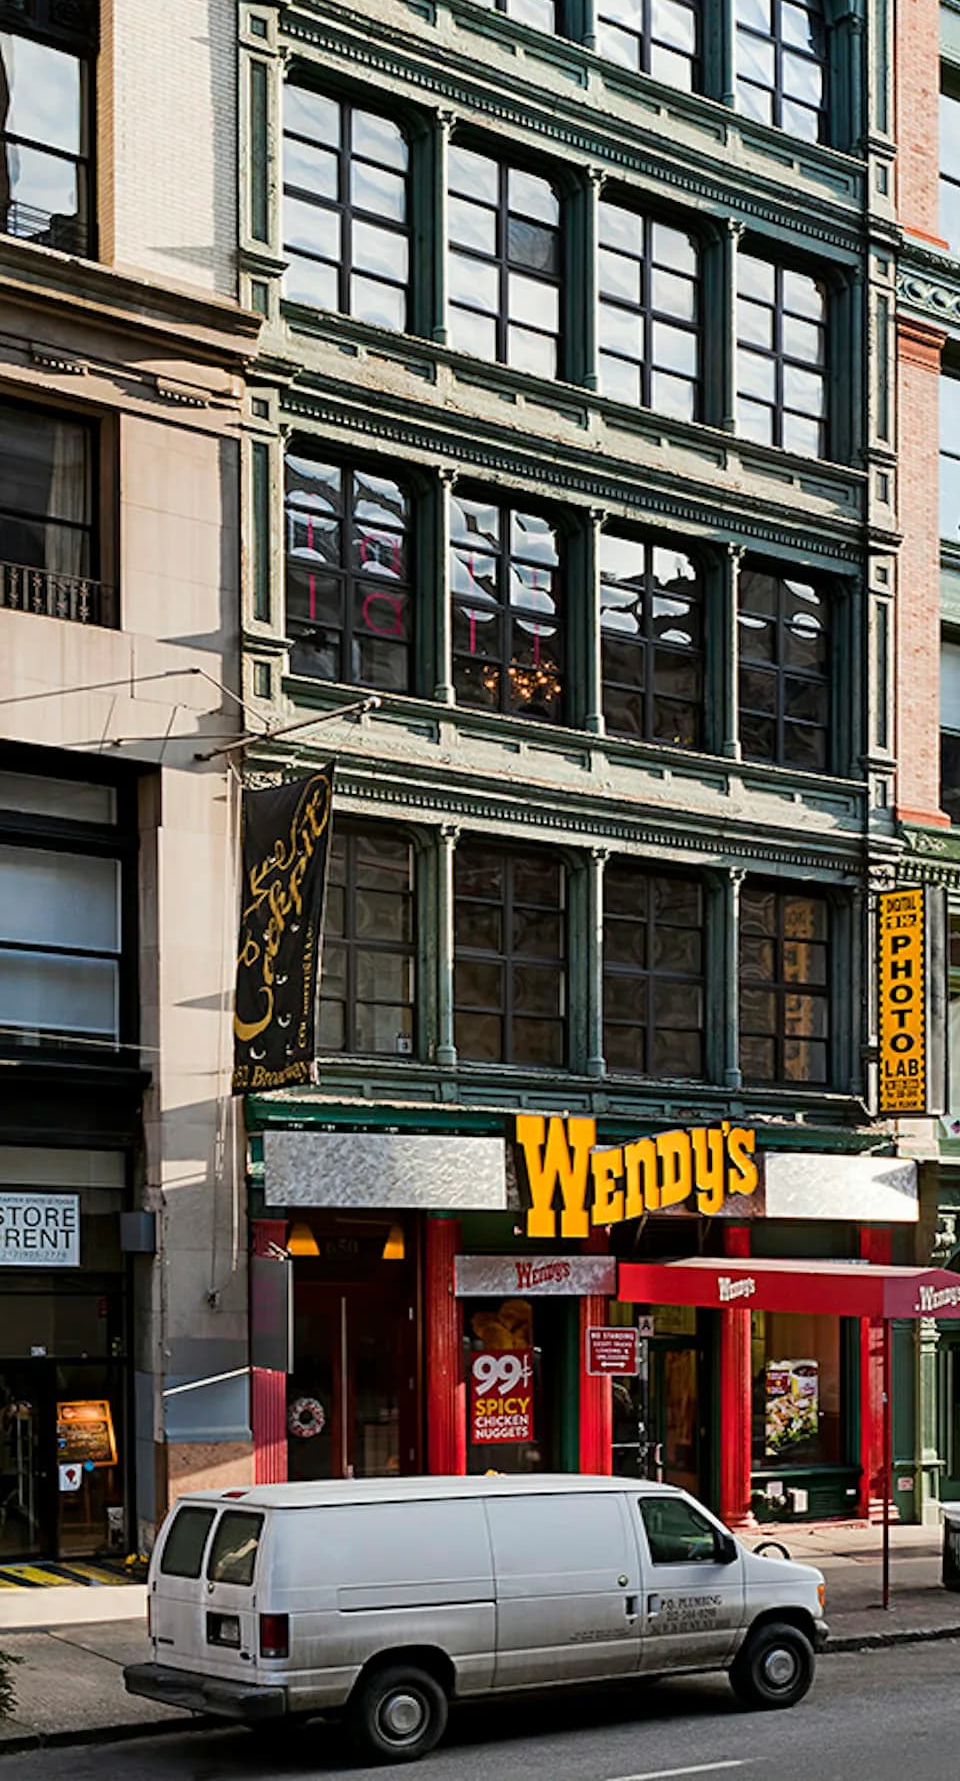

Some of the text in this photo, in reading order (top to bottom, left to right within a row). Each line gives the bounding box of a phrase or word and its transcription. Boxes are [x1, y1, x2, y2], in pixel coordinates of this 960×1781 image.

[889, 935, 915, 1053] PHOTO
[885, 1059, 919, 1077] LAB
[516, 1114, 758, 1238] Wendy's
[5, 1228, 76, 1249] RENT
[515, 1262, 570, 1288] Wendy's
[718, 1277, 756, 1301] Wendy's
[602, 1332, 635, 1340] STANDING
[475, 1398, 531, 1416] SPICY
[474, 1415, 529, 1428] CHICKEN
[475, 1426, 529, 1440] NUGGETS
